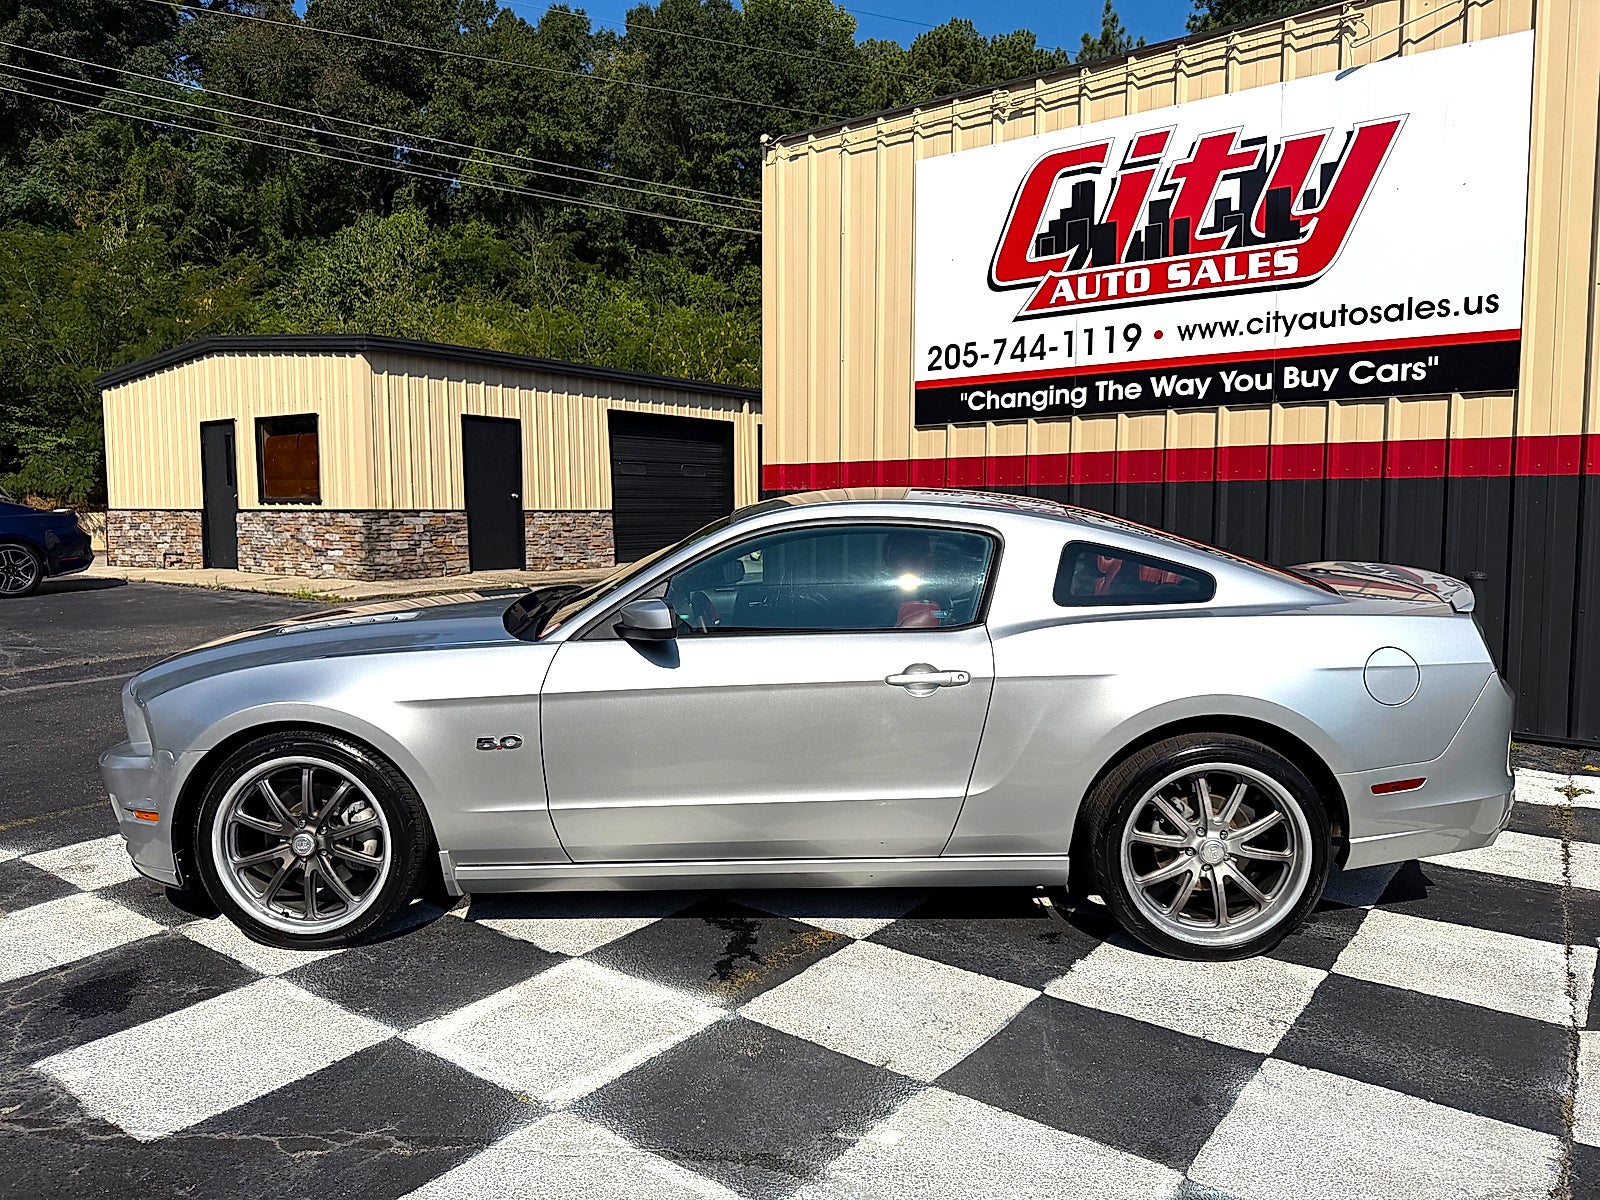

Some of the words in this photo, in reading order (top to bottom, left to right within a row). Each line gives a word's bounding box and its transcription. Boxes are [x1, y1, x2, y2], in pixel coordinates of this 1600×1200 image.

[988, 113, 1410, 287] City
[1050, 267, 1150, 304] AUTO
[1167, 247, 1299, 289] SALES
[927, 322, 1142, 371] 205-744-1119
[1177, 293, 1500, 341] www.cityautosales.us
[960, 384, 1087, 412] "Changing
[1095, 376, 1142, 401] The
[1150, 374, 1212, 400] Way
[1219, 371, 1273, 393] You
[1283, 366, 1339, 391] Buy
[1349, 356, 1439, 385] Cars"
[476, 734, 523, 751] 5.0
